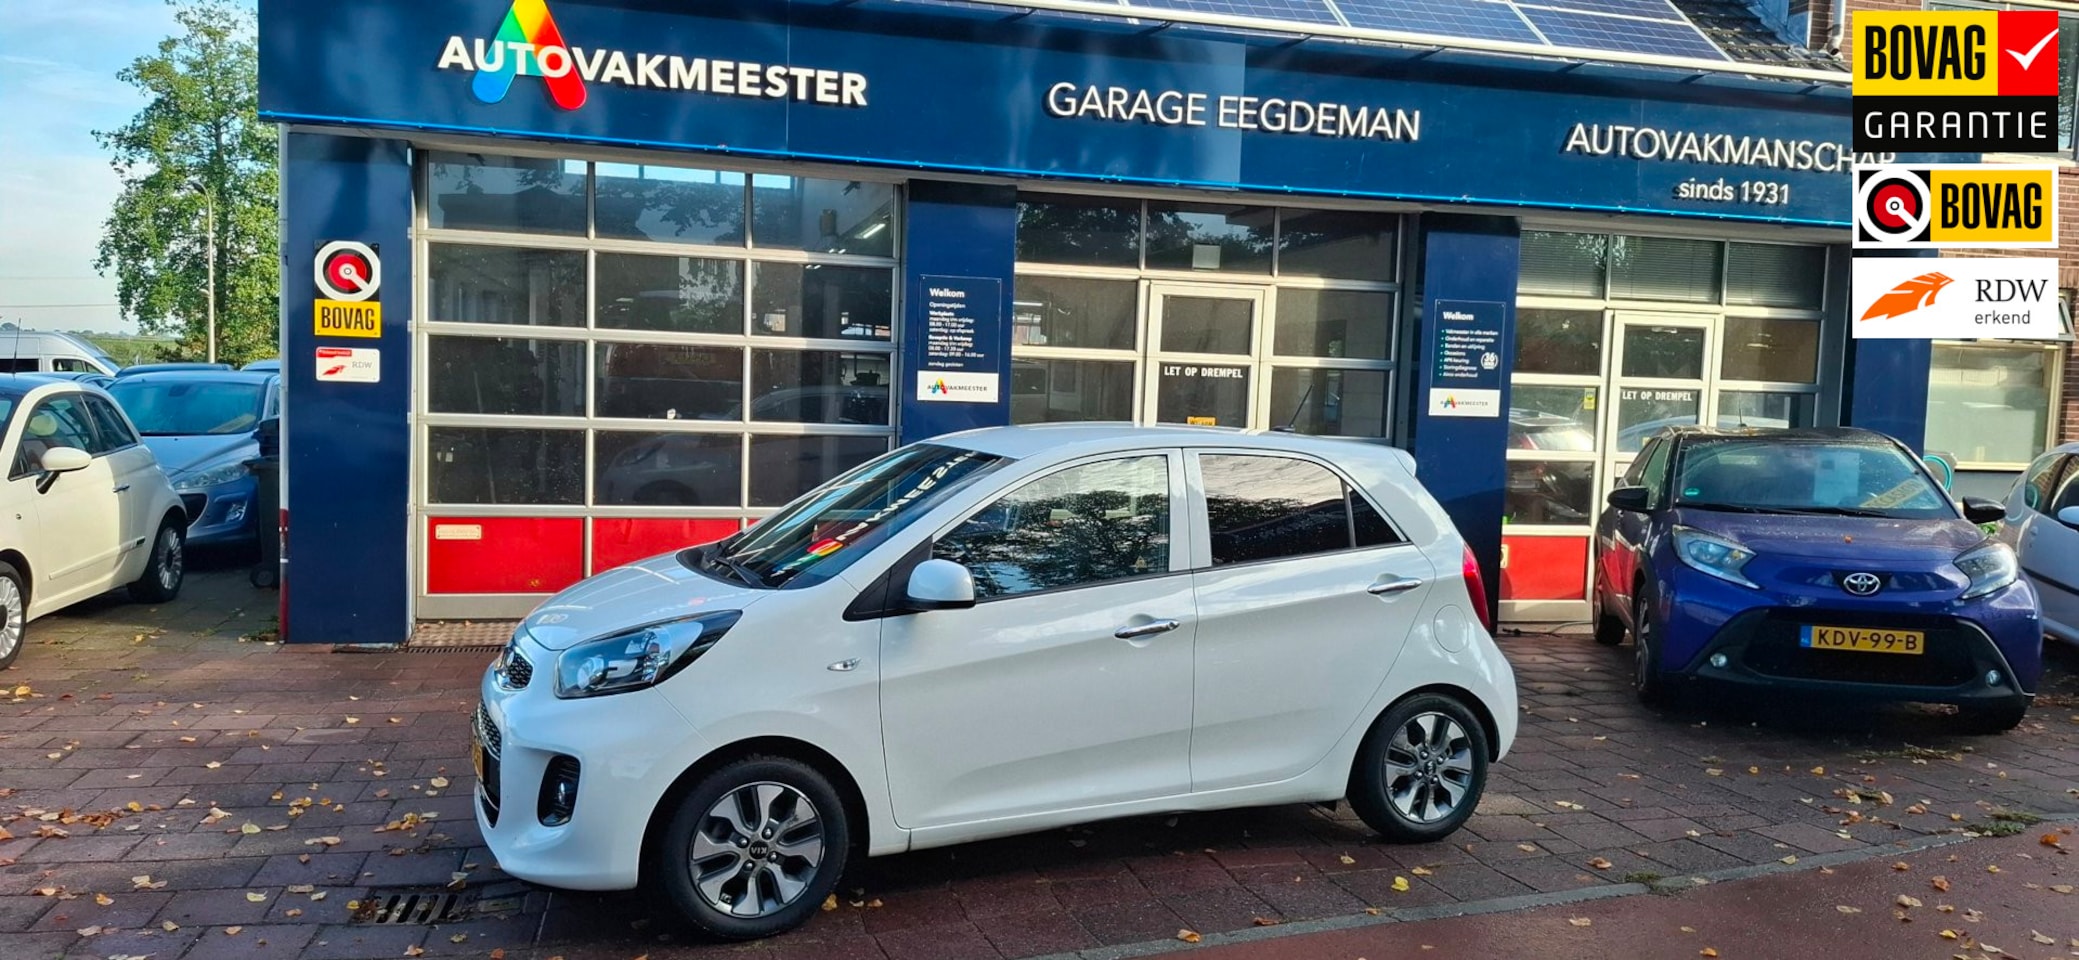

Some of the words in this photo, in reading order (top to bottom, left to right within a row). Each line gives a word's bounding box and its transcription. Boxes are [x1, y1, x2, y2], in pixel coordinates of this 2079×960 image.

[437, 35, 868, 106] AUTOVAKMEESTER
[1048, 82, 1207, 126] GARAGE
[1218, 96, 1421, 141] EEGDEMAN
[1679, 178, 1734, 201] sinds
[1741, 181, 1790, 204] 1931
[929, 287, 965, 298] Welkom
[321, 306, 375, 331] BOVAG
[1443, 311, 1474, 321] Welkom
[352, 361, 372, 369] RDW
[1164, 366, 1181, 376] LET
[1185, 366, 1198, 377] OP
[1201, 367, 1243, 378] DREMPEL
[1622, 391, 1637, 400] LET
[1640, 391, 1653, 400] OP
[1655, 391, 1692, 401] DREMPEL
[1817, 629, 1918, 650] KDV-99-B
[750, 846, 768, 855] KIA
